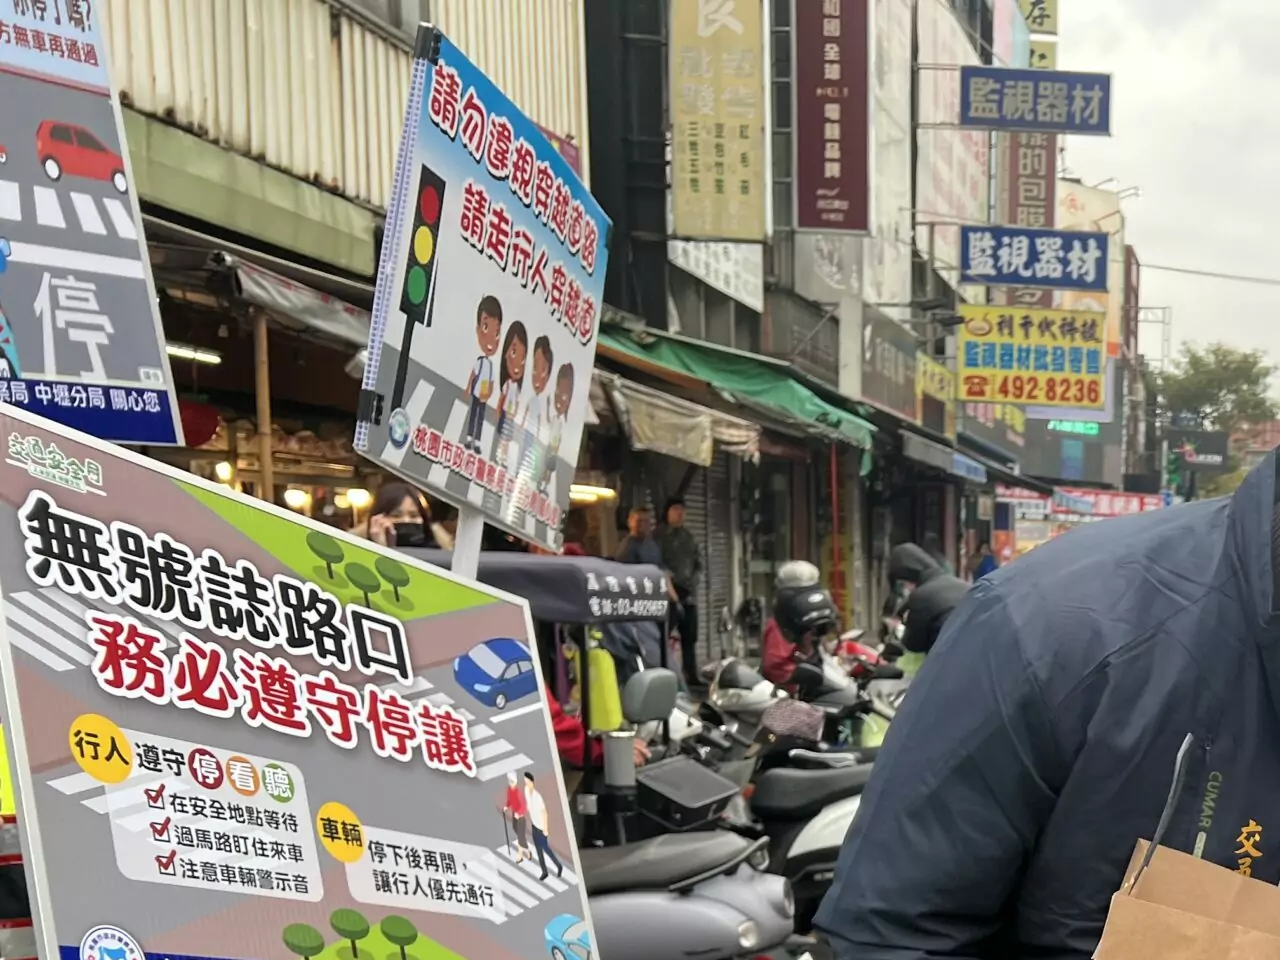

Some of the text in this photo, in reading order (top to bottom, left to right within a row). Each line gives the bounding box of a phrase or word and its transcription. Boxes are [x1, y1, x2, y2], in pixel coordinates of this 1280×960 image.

[967, 76, 1104, 126] 監視器材
[430, 61, 598, 272] 請勿違規穿越道路
[460, 182, 595, 341] 請走行人穿越道
[966, 230, 1102, 282] 監視器材
[33, 271, 115, 384] 停
[34, 383, 105, 409] 中壢分局
[109, 388, 161, 413] 關心您
[997, 375, 1100, 404] 492-8236
[24, 497, 411, 681] 無號誌路口
[91, 614, 474, 772] 務必遵守停讓
[73, 728, 131, 767] 行人
[169, 792, 299, 833] 在安全地點等待
[1199, 770, 1222, 828] CUMAR
[174, 825, 305, 863] 過馬路盯住來車
[320, 816, 364, 848] 車輛
[179, 857, 309, 894] 注意車輛警示音
[372, 868, 495, 908] 讓行人優先通行
